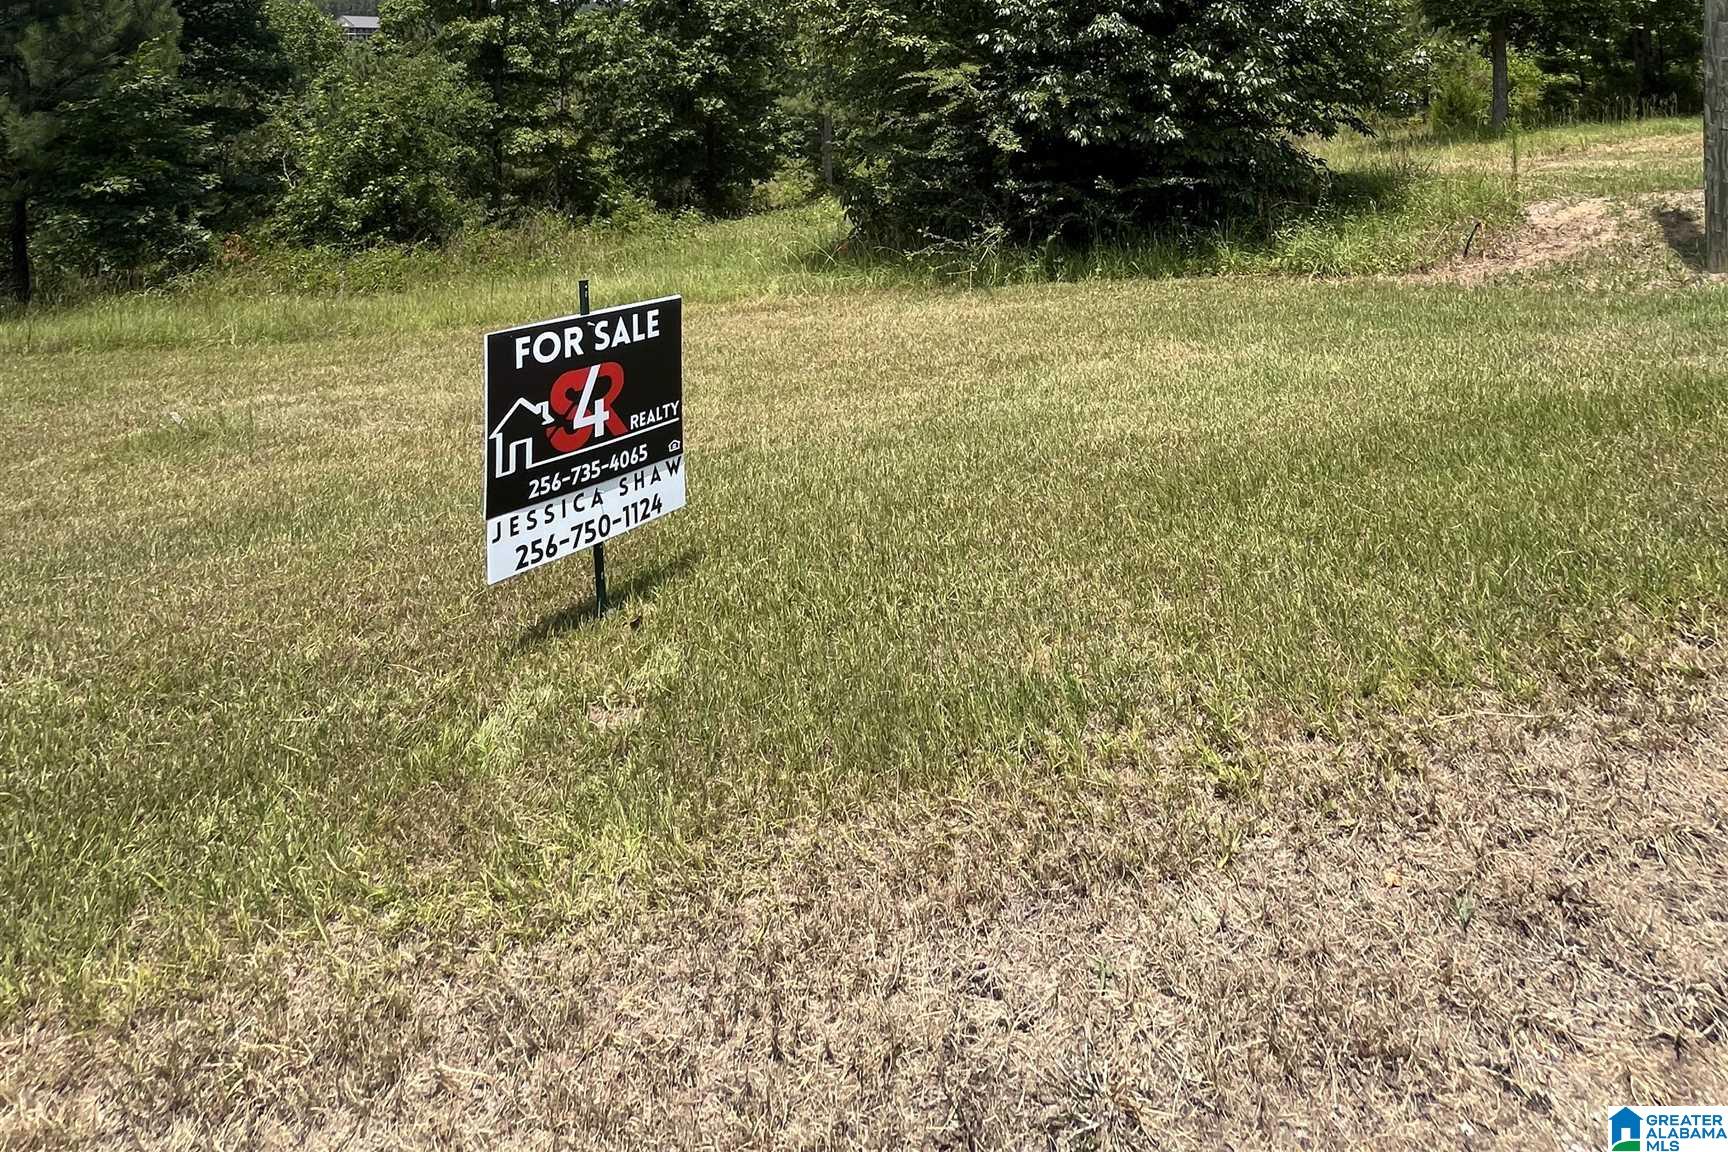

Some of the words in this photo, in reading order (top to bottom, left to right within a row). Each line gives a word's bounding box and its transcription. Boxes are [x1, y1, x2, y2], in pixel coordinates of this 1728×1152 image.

[515, 326, 584, 370] FOR
[594, 309, 660, 351] SALE
[630, 400, 680, 431] REALTY
[492, 488, 604, 544] JESSICA
[619, 456, 682, 497] SHAW
[528, 444, 648, 499] 256-735-4065
[515, 493, 663, 571] 256-750-1124
